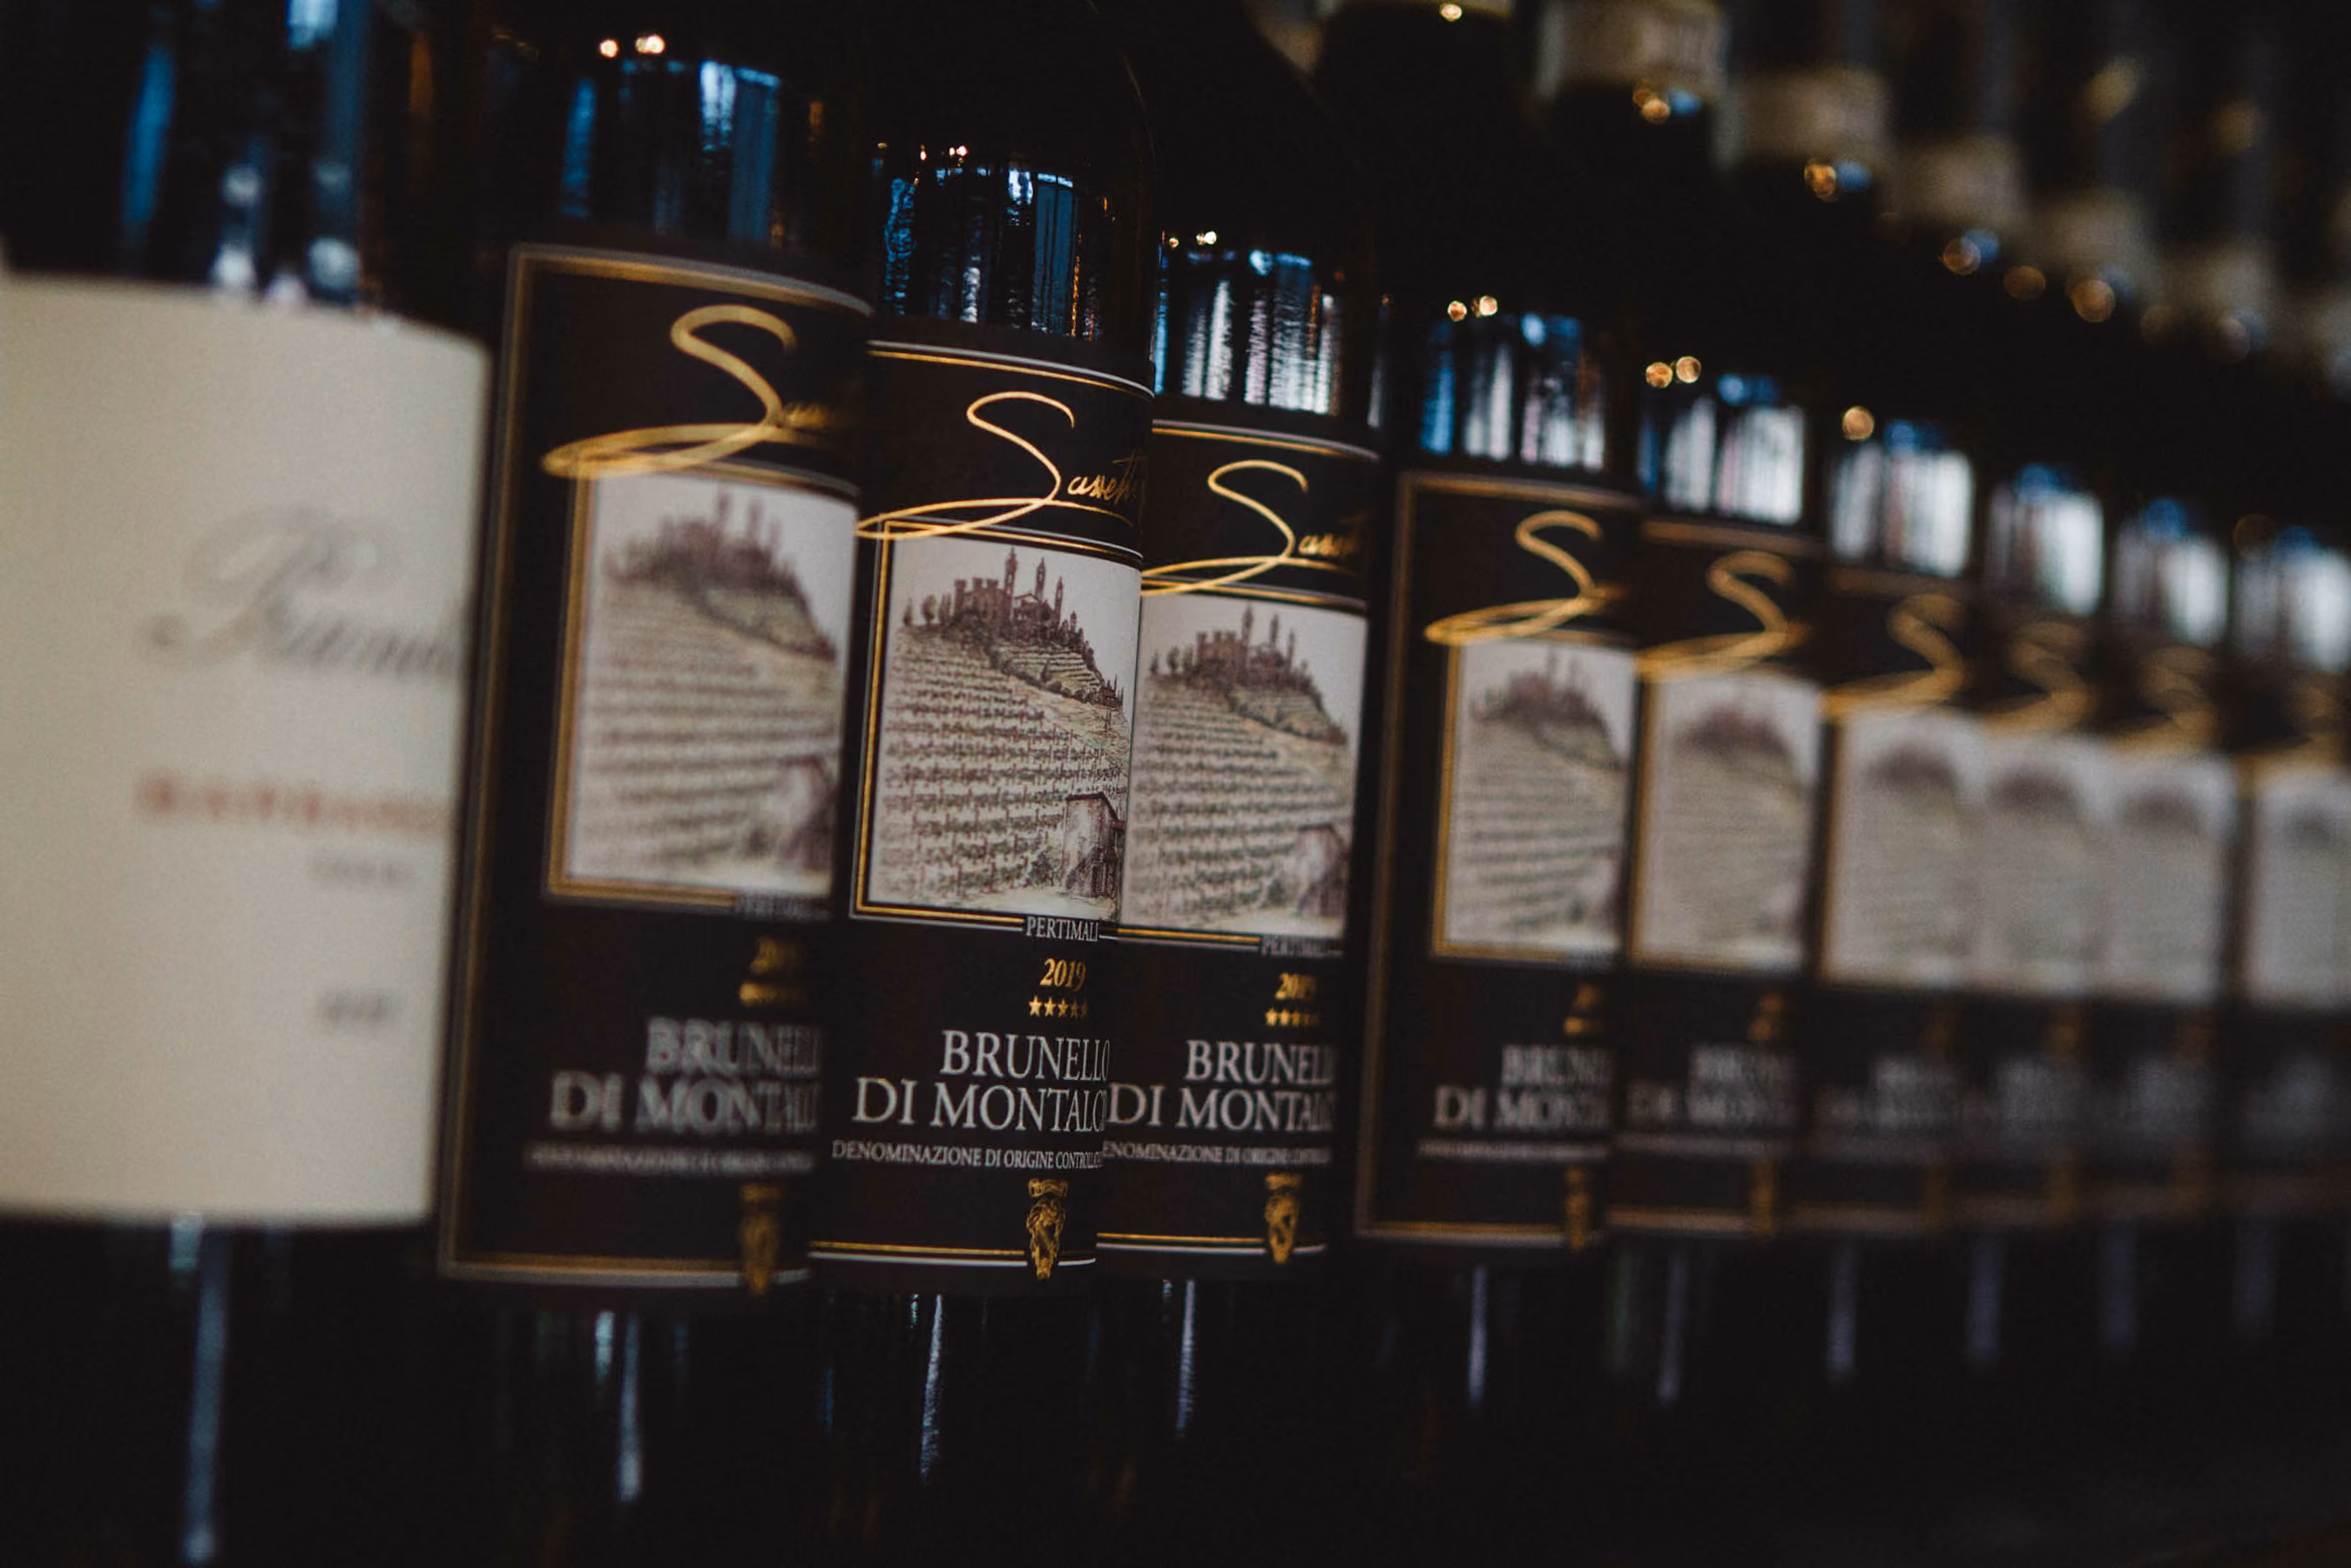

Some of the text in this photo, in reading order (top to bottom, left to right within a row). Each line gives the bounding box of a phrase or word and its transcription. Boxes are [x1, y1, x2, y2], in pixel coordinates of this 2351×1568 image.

[1026, 916, 1099, 942] PERTIMALI
[1039, 957, 1086, 991] 2019
[940, 1029, 1111, 1081] BRUNELLO
[551, 1070, 622, 1130] DI
[853, 1076, 917, 1125] DI
[1106, 1082, 1166, 1126] DI
[832, 1139, 982, 1167] DENOMINAZIONE
[985, 1148, 1001, 1167] DI
[1003, 1149, 1054, 1169] ORIGINE
[1103, 1140, 1223, 1164] ENOMINAZIONE
